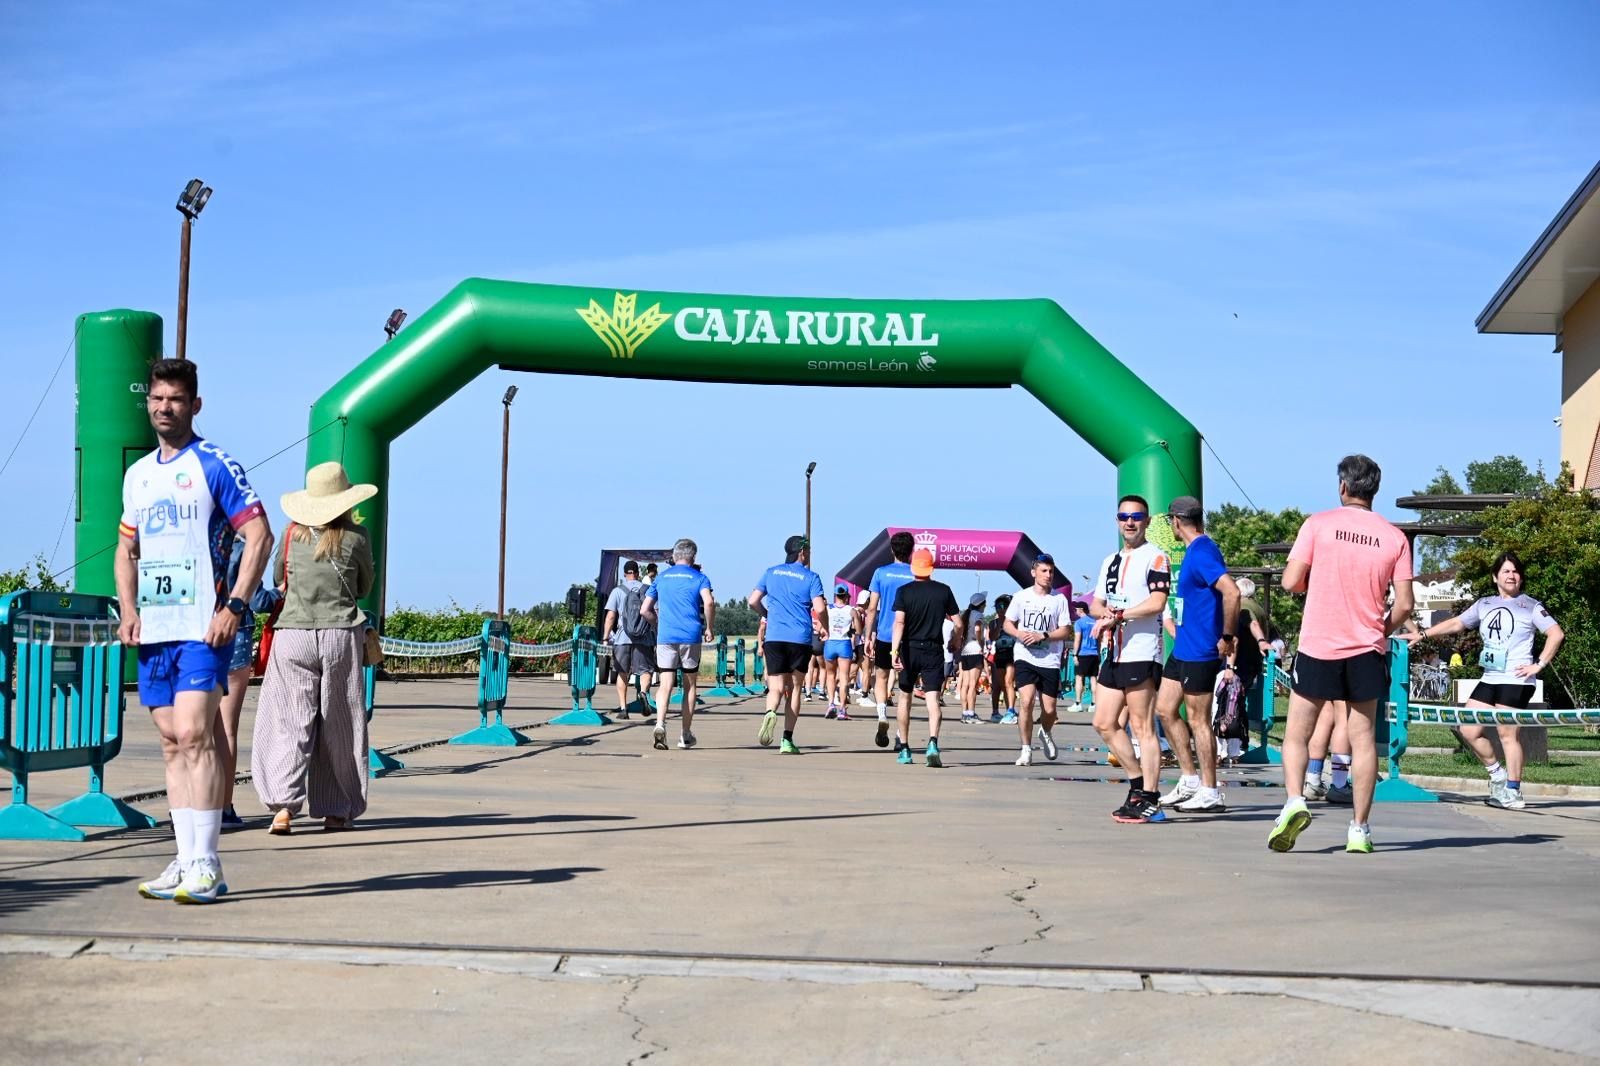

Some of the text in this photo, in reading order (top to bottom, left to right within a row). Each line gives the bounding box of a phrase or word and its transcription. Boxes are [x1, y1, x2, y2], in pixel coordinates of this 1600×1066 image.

[674, 307, 939, 346] CAJA RURAL
[807, 357, 908, 372] somos León
[1335, 529, 1381, 548] BURBIA
[940, 543, 996, 554] DIPUTACIÓN
[940, 553, 978, 562] DE LEÓN
[155, 575, 172, 595] 73
[1484, 651, 1494, 663] 54
